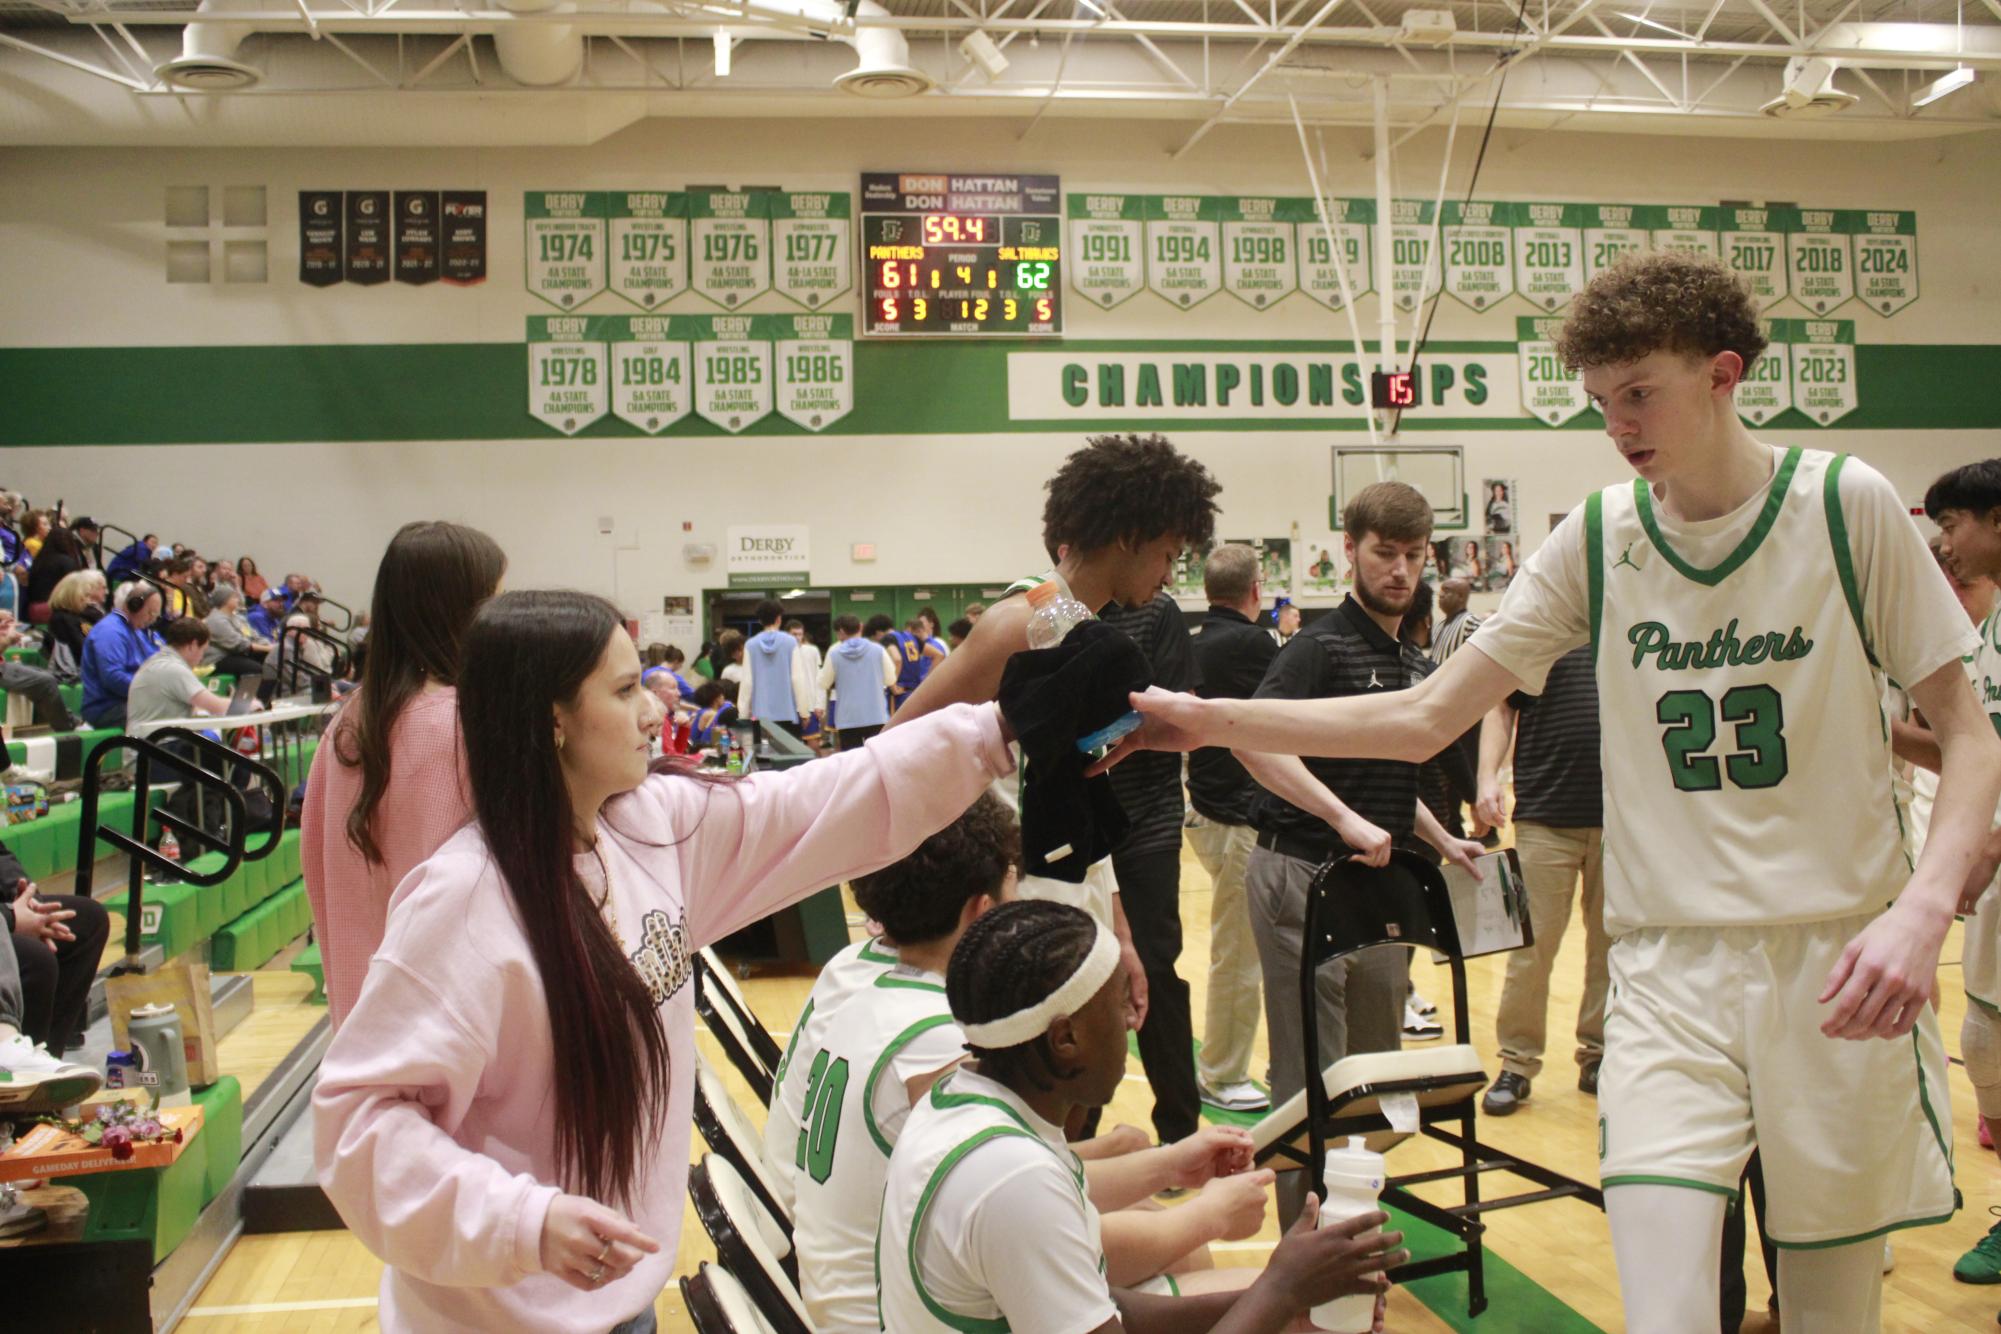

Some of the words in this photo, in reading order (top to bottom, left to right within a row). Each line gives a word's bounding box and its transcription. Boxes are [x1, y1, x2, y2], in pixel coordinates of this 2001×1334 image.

[905, 178, 944, 191] DON
[952, 179, 1018, 192] HATTAN
[545, 194, 586, 209] DERBY
[628, 194, 668, 209] DERBY
[710, 194, 750, 210] DERBY
[791, 194, 830, 210] DERBY
[905, 196, 944, 208] DON
[952, 196, 1018, 210] HATTAN
[926, 216, 983, 242] 59.4
[540, 234, 592, 262] 1974
[622, 234, 675, 262] 1975
[704, 234, 758, 262] 1976
[786, 234, 838, 262] 1977
[870, 246, 924, 260] PANTHERS
[1082, 235, 1132, 262] 1991
[1157, 236, 1210, 262] 1994
[1232, 237, 1285, 263] 1998
[1308, 238, 1358, 264] 199
[1450, 240, 1505, 266] 2008
[1526, 242, 1571, 268] 2013
[948, 254, 977, 263] PERIOD
[1731, 246, 1775, 271] 2017
[1796, 248, 1842, 272] 2018
[1860, 248, 1908, 273] 2024
[562, 267, 586, 277] STATE
[644, 267, 667, 277] STATE
[726, 268, 750, 277] STATE
[814, 268, 837, 277] STATE
[882, 261, 917, 288] 61
[956, 266, 971, 284] 4
[1016, 262, 1050, 288] 62
[1101, 266, 1124, 276] STATE
[1178, 268, 1202, 278] STATE
[1254, 268, 1276, 278] STATE
[1474, 272, 1495, 282] STATE
[1544, 272, 1565, 282] STATE
[542, 278, 592, 288] CHAMPIONS
[624, 278, 674, 288] CHAMPIONS
[706, 278, 756, 288] CHAMPIONS
[788, 279, 838, 288] CHAMPIONS
[1084, 278, 1131, 288] CHAMPIONS
[1161, 278, 1208, 289] CHAMPIONS
[1237, 279, 1283, 289] CHAMPIONS
[1816, 278, 1835, 286] STATE
[1882, 278, 1900, 287] STATE
[1800, 288, 1840, 297] CHAMPIONS
[1866, 288, 1906, 298] CHAMPIONS
[882, 298, 898, 320] 5
[914, 298, 926, 320] 3
[962, 298, 988, 320] 12
[1004, 298, 1017, 320] 3
[1036, 299, 1052, 320] 5
[547, 318, 588, 333] DERBY
[630, 318, 670, 333] DERBY
[712, 316, 752, 332] DERBY
[793, 316, 833, 332] DERBY
[540, 358, 596, 386] 1978
[622, 358, 681, 385] 1984
[706, 356, 762, 384] 1985
[787, 356, 843, 383] 1986
[1800, 358, 1846, 382] 2023
[1061, 362, 1488, 406] CHAMPIONSIPS
[564, 392, 588, 402] STATE
[646, 391, 671, 400] STATE
[728, 390, 753, 400] STATE
[810, 389, 834, 399] STATE
[544, 402, 595, 414] CHAMPIONS
[626, 402, 678, 412] CHAMPIONS
[709, 401, 759, 412] CHAMPIONS
[790, 400, 840, 410] CHAMPIONS
[740, 537, 795, 553] DERBY
[1627, 618, 1814, 670] Panthers
[1656, 683, 1789, 792] 23
[32, 1161, 80, 1174] GAMEDAY
